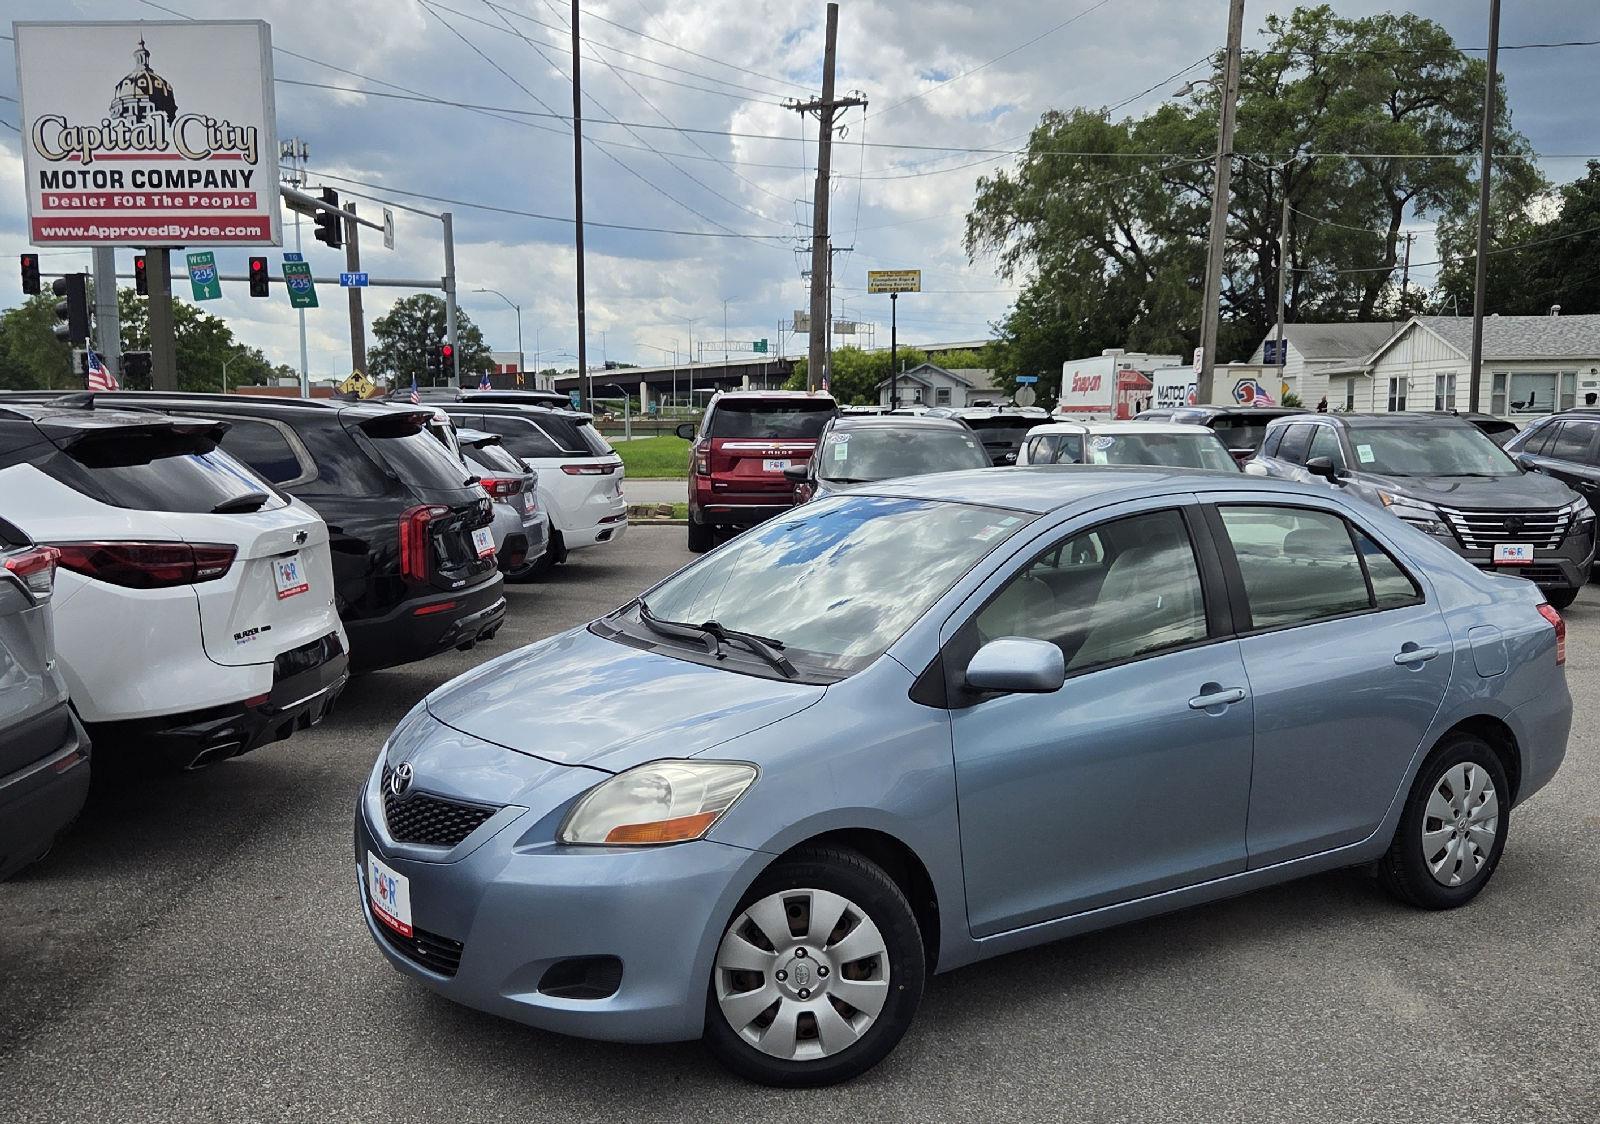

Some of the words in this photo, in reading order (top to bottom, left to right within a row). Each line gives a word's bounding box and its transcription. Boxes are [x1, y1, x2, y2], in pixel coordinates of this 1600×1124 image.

[32, 114, 170, 166] Capital
[173, 113, 258, 165] City
[40, 170, 124, 189] MOTOR
[131, 169, 254, 189] COMPANY
[49, 195, 106, 207] Dealer
[113, 195, 146, 207] FOR
[152, 195, 183, 207] The
[189, 194, 250, 209] People
[41, 225, 261, 239] www.ApprovedByJoe.com
[189, 255, 211, 264] WEST
[194, 268, 214, 280] 235
[285, 265, 306, 273] EAST
[290, 279, 310, 288] 235
[1157, 385, 1185, 399] MATCO
[1502, 547, 1523, 556] FOR
[279, 562, 298, 583] FOR
[373, 866, 397, 907] FOR
